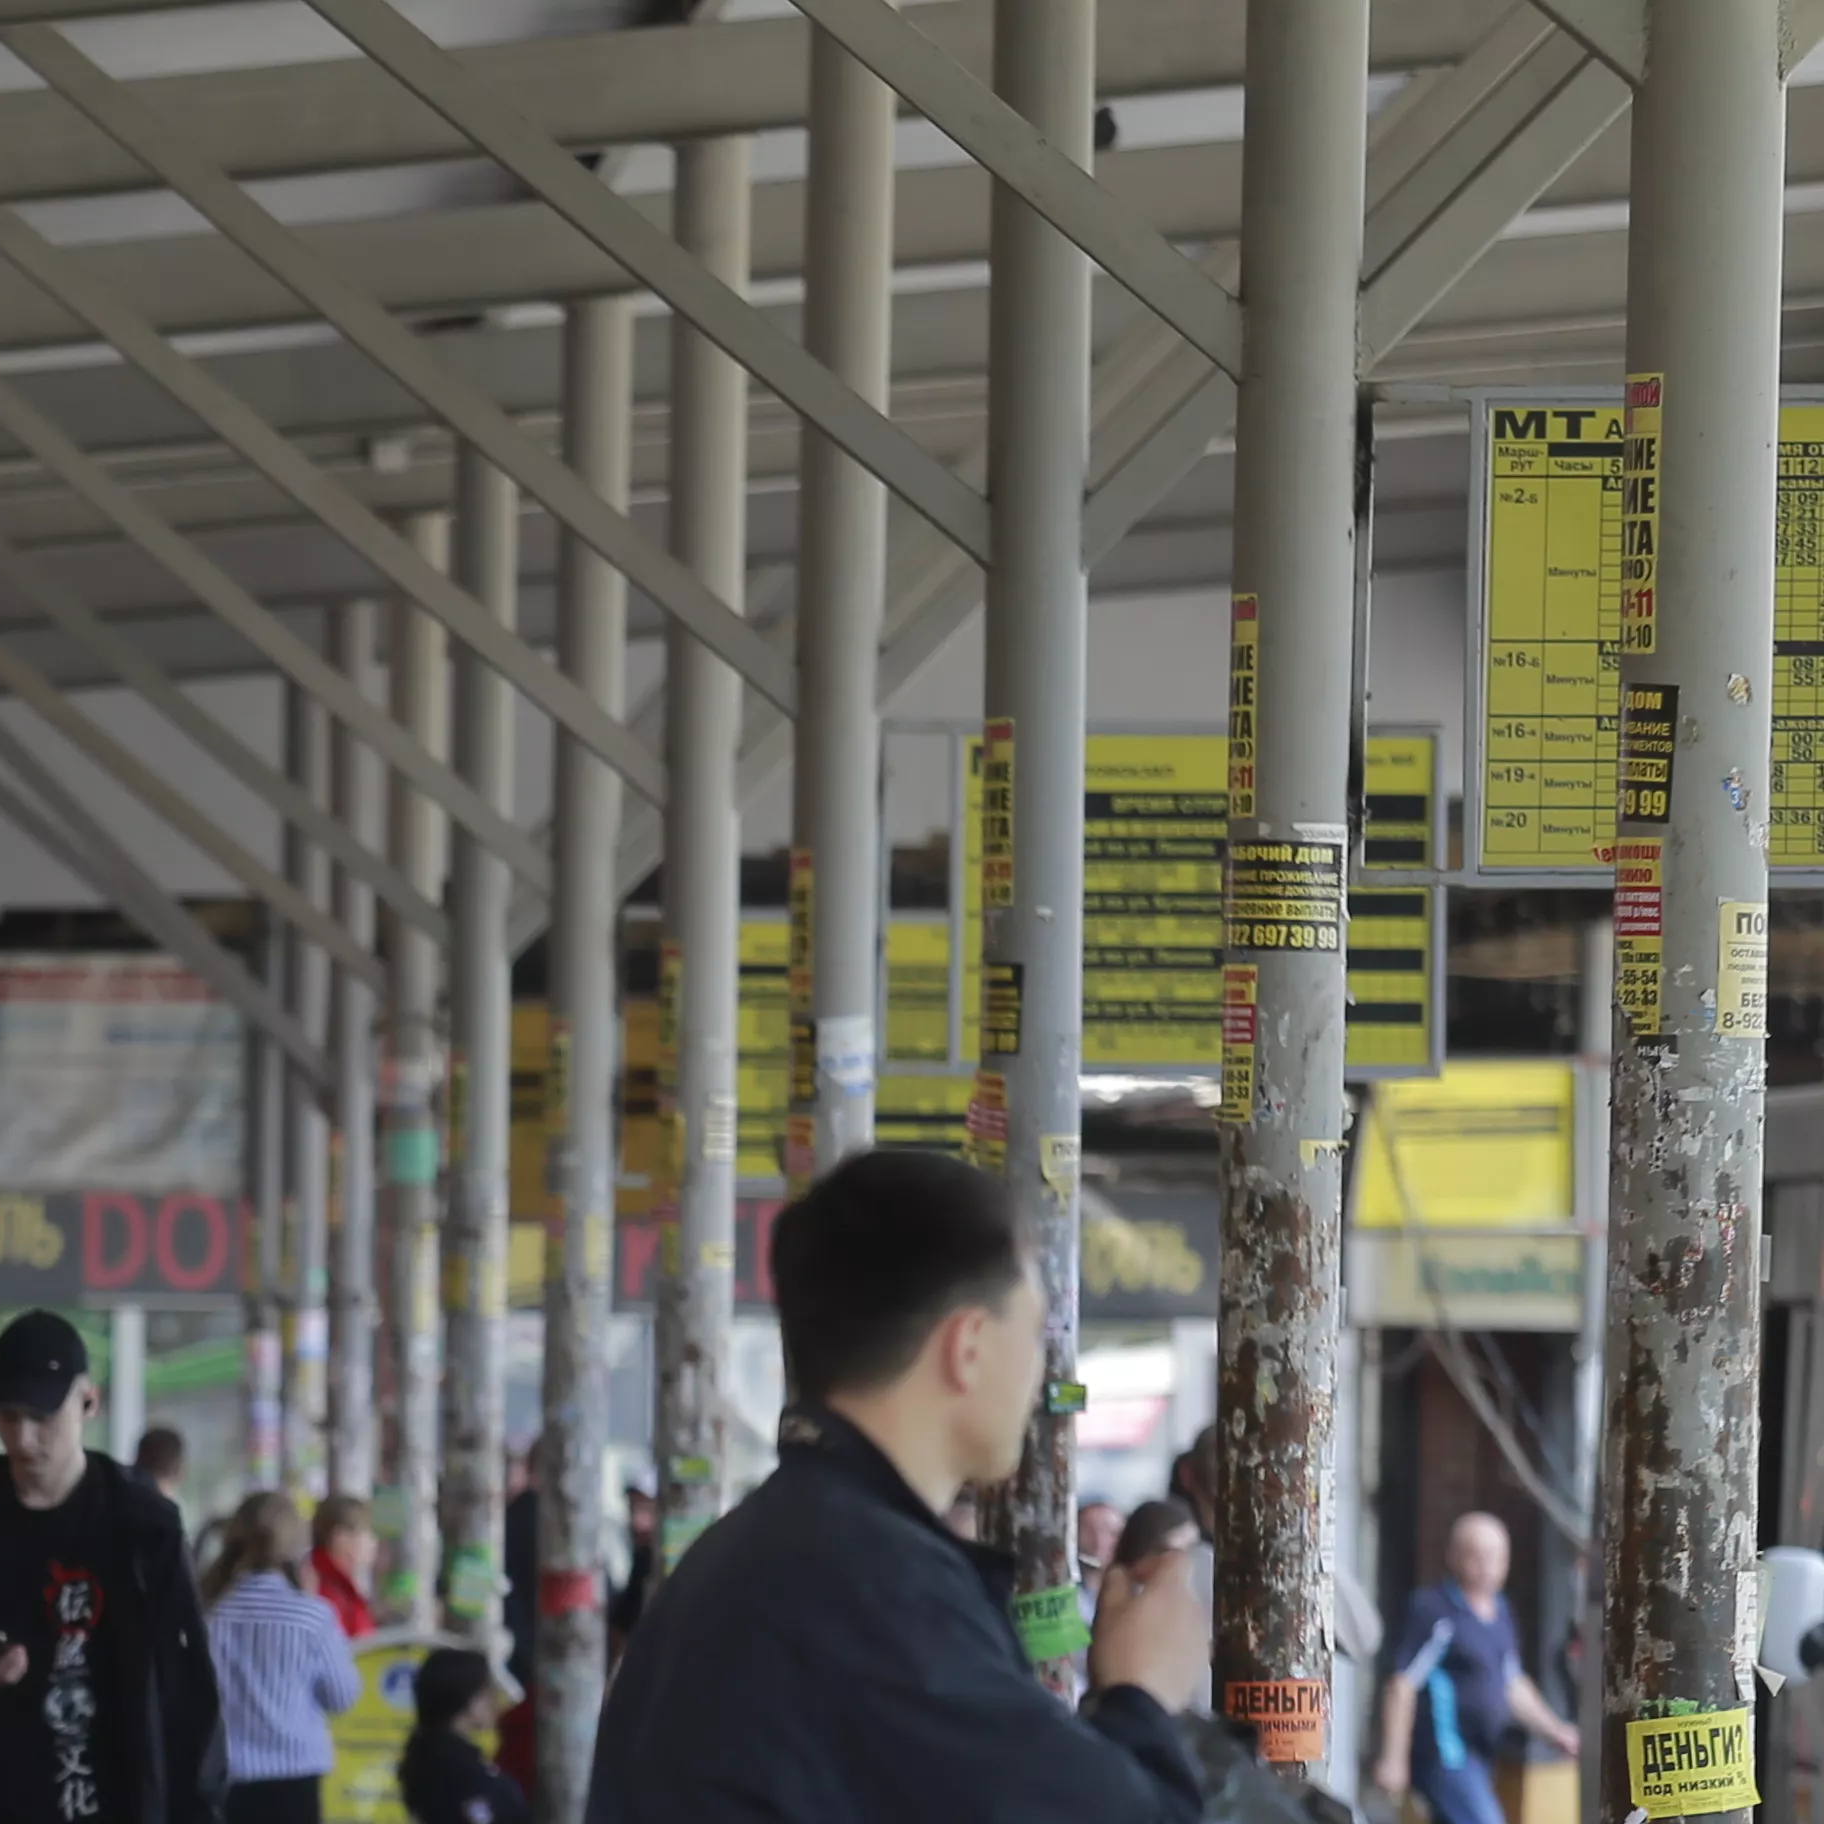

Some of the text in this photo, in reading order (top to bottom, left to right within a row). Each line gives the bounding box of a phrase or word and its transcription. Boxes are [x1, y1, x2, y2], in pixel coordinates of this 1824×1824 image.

[1511, 460, 1534, 472] рут
[1554, 460, 1593, 471] Часы
[1796, 460, 1819, 475] 12
[1798, 493, 1819, 505] 09
[1797, 508, 1818, 520] 21
[1796, 522, 1817, 536] 33
[1548, 567, 1596, 578] Минуты
[1546, 674, 1594, 686] Минуты
[1793, 672, 1814, 686] 55
[1544, 731, 1592, 743] Минуты
[1792, 733, 1813, 746] 00
[1544, 778, 1592, 791] Минуты
[1639, 790, 1667, 817] 99
[1790, 811, 1810, 824] 36
[1543, 823, 1591, 836] Минуты
[1295, 847, 1334, 865] ДОМ
[1253, 924, 1289, 948] 697
[1290, 925, 1316, 949] 39
[1317, 926, 1337, 950] 99
[1234, 1685, 1321, 1719] ДЕНЬГИ
[1642, 1723, 1743, 1783] ДЕНЬГИ?
[1643, 1783, 1674, 1797] под
[1678, 1773, 1734, 1793] низкий
